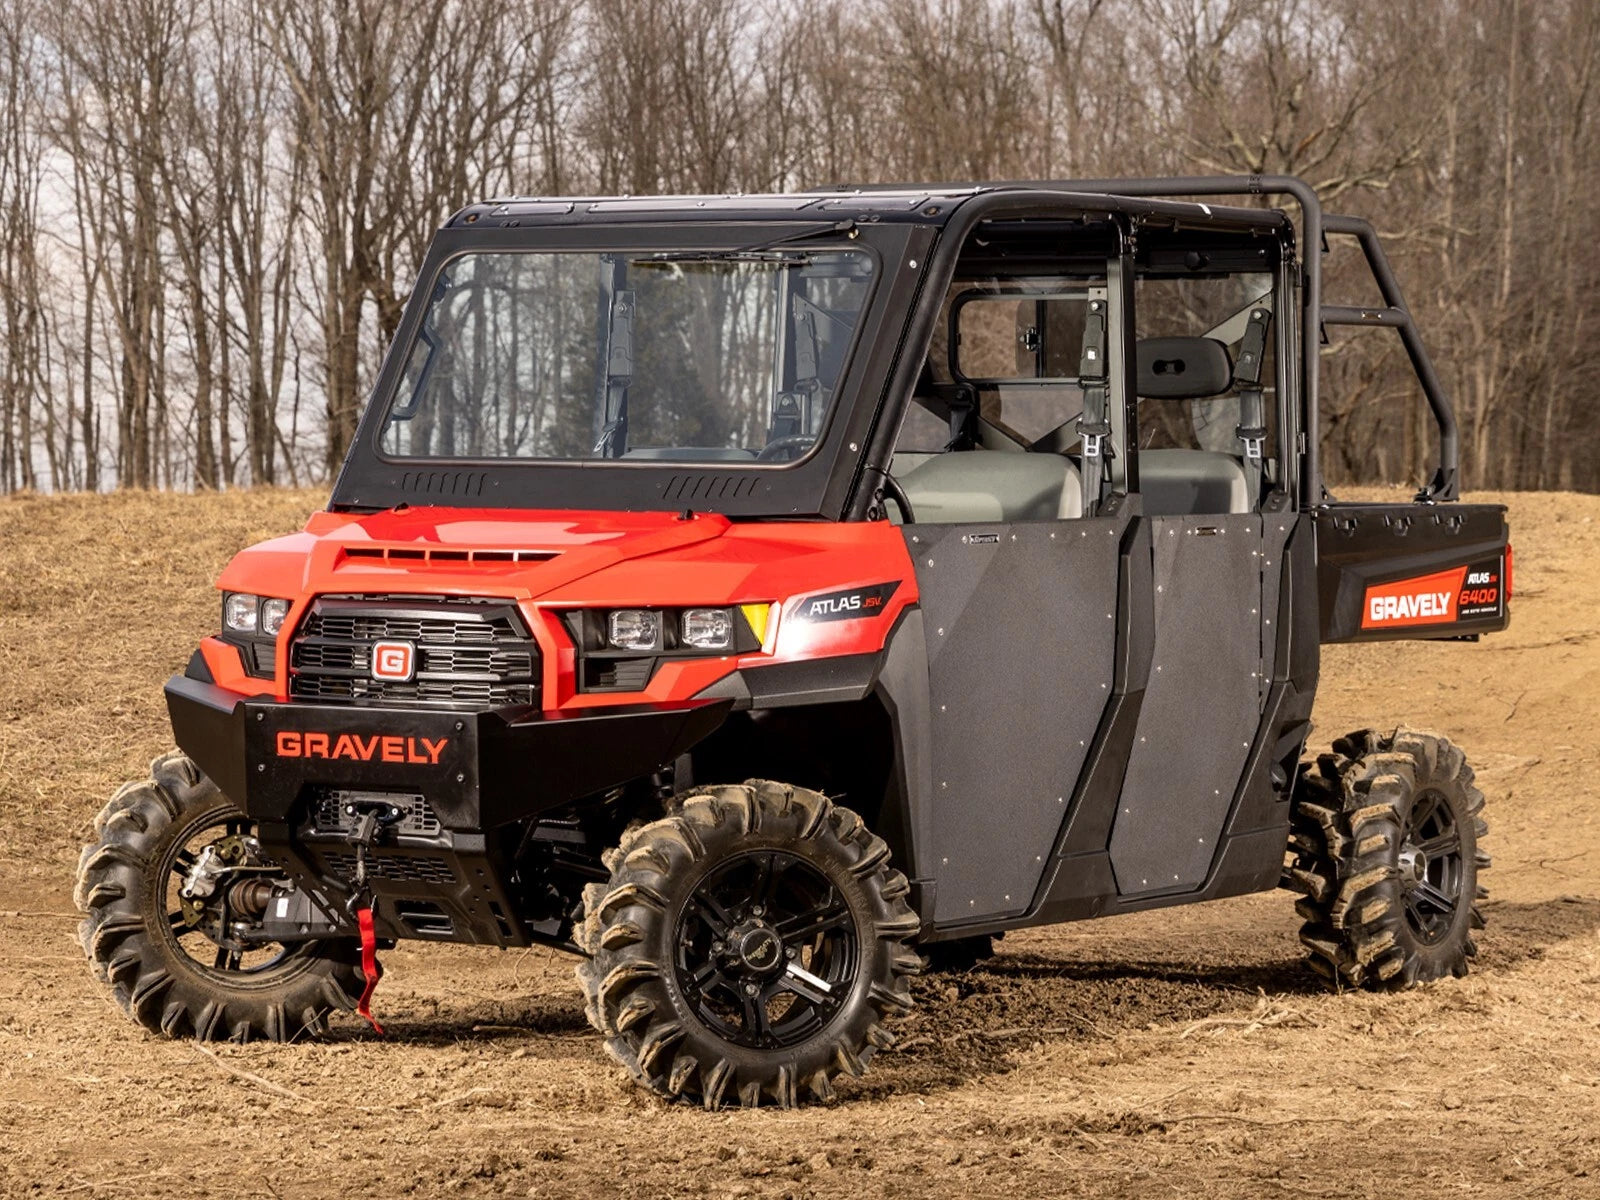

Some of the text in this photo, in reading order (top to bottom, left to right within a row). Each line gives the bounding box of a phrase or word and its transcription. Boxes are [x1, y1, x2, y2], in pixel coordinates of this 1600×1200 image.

[1467, 572, 1490, 584] ATLAS
[810, 595, 860, 616] ATLAS
[1370, 592, 1451, 621] GRAVELY
[1459, 588, 1497, 605] 6400
[276, 731, 448, 764] GRAVELY
